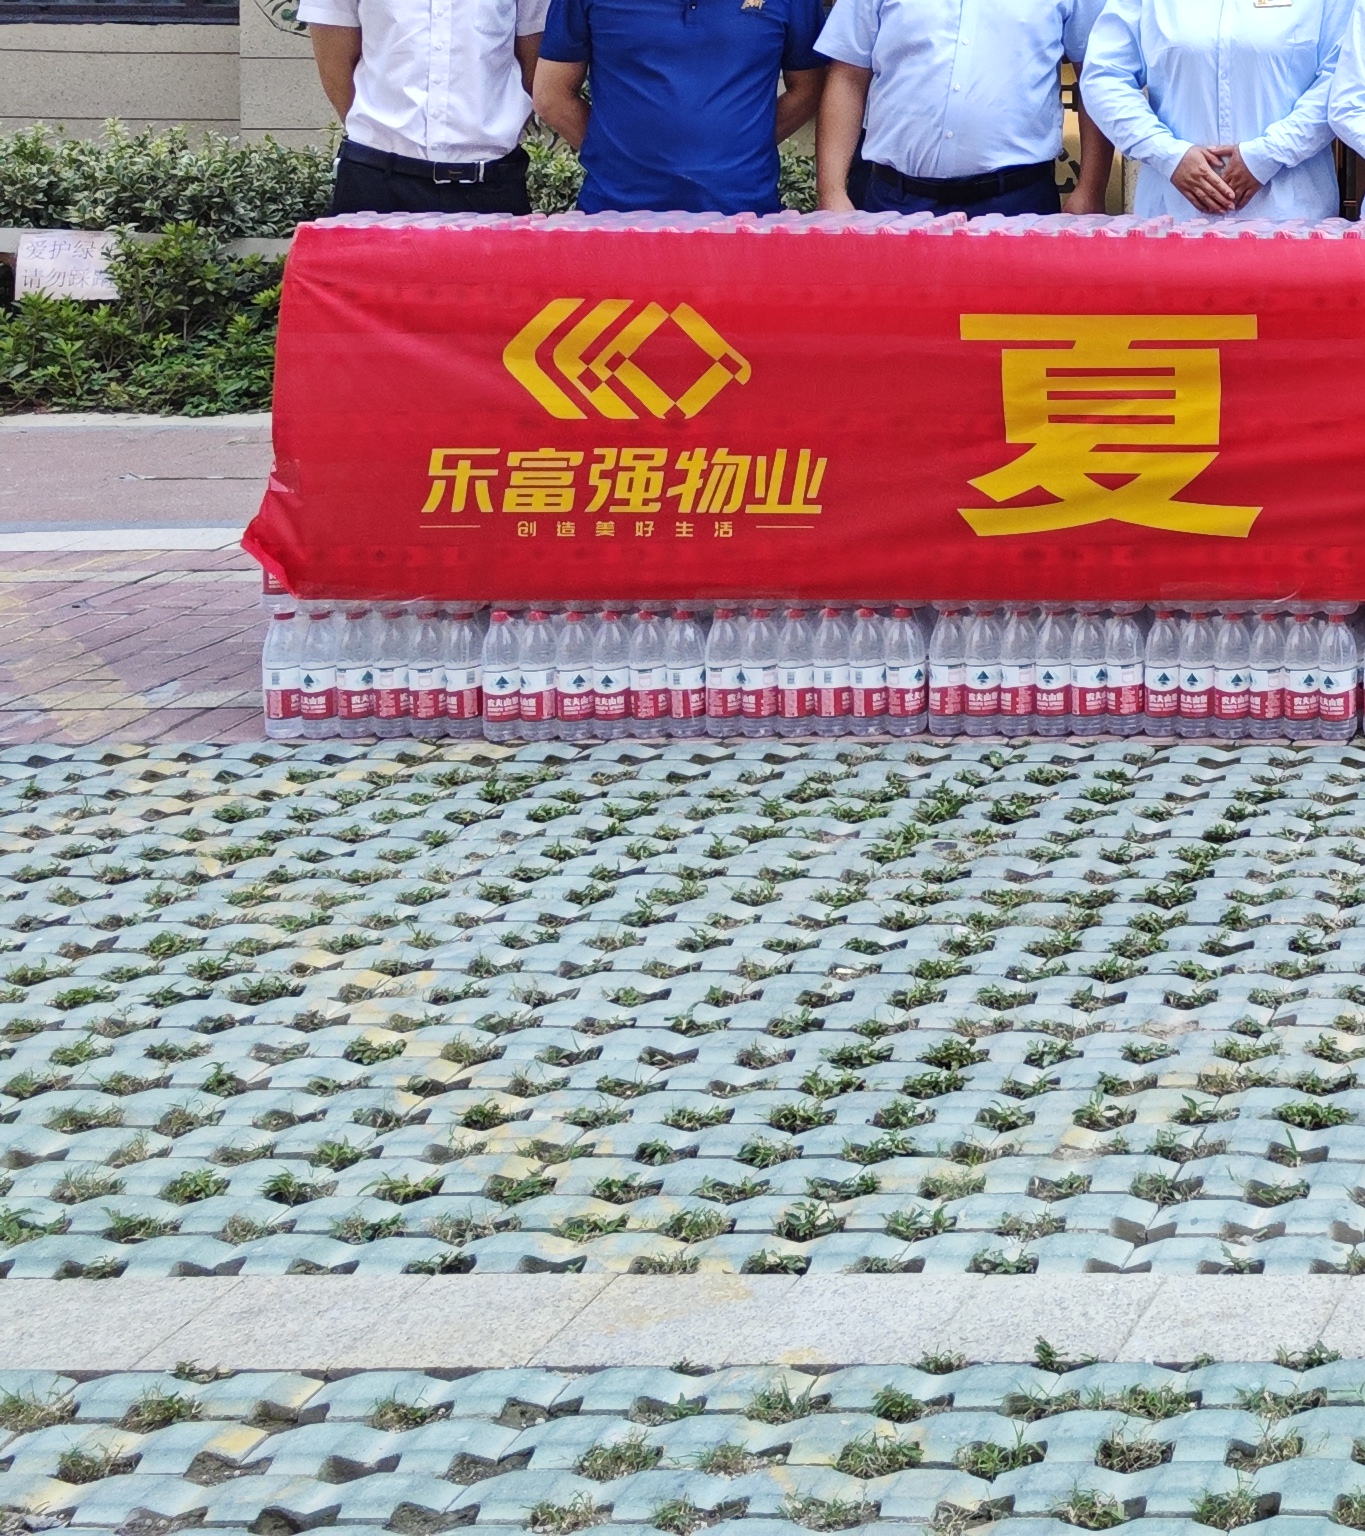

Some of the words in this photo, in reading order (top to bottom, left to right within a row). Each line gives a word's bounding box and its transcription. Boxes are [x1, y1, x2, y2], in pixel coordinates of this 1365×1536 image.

[421, 447, 828, 514] 乐富强物业
[516, 520, 734, 538] 创造美好生活
